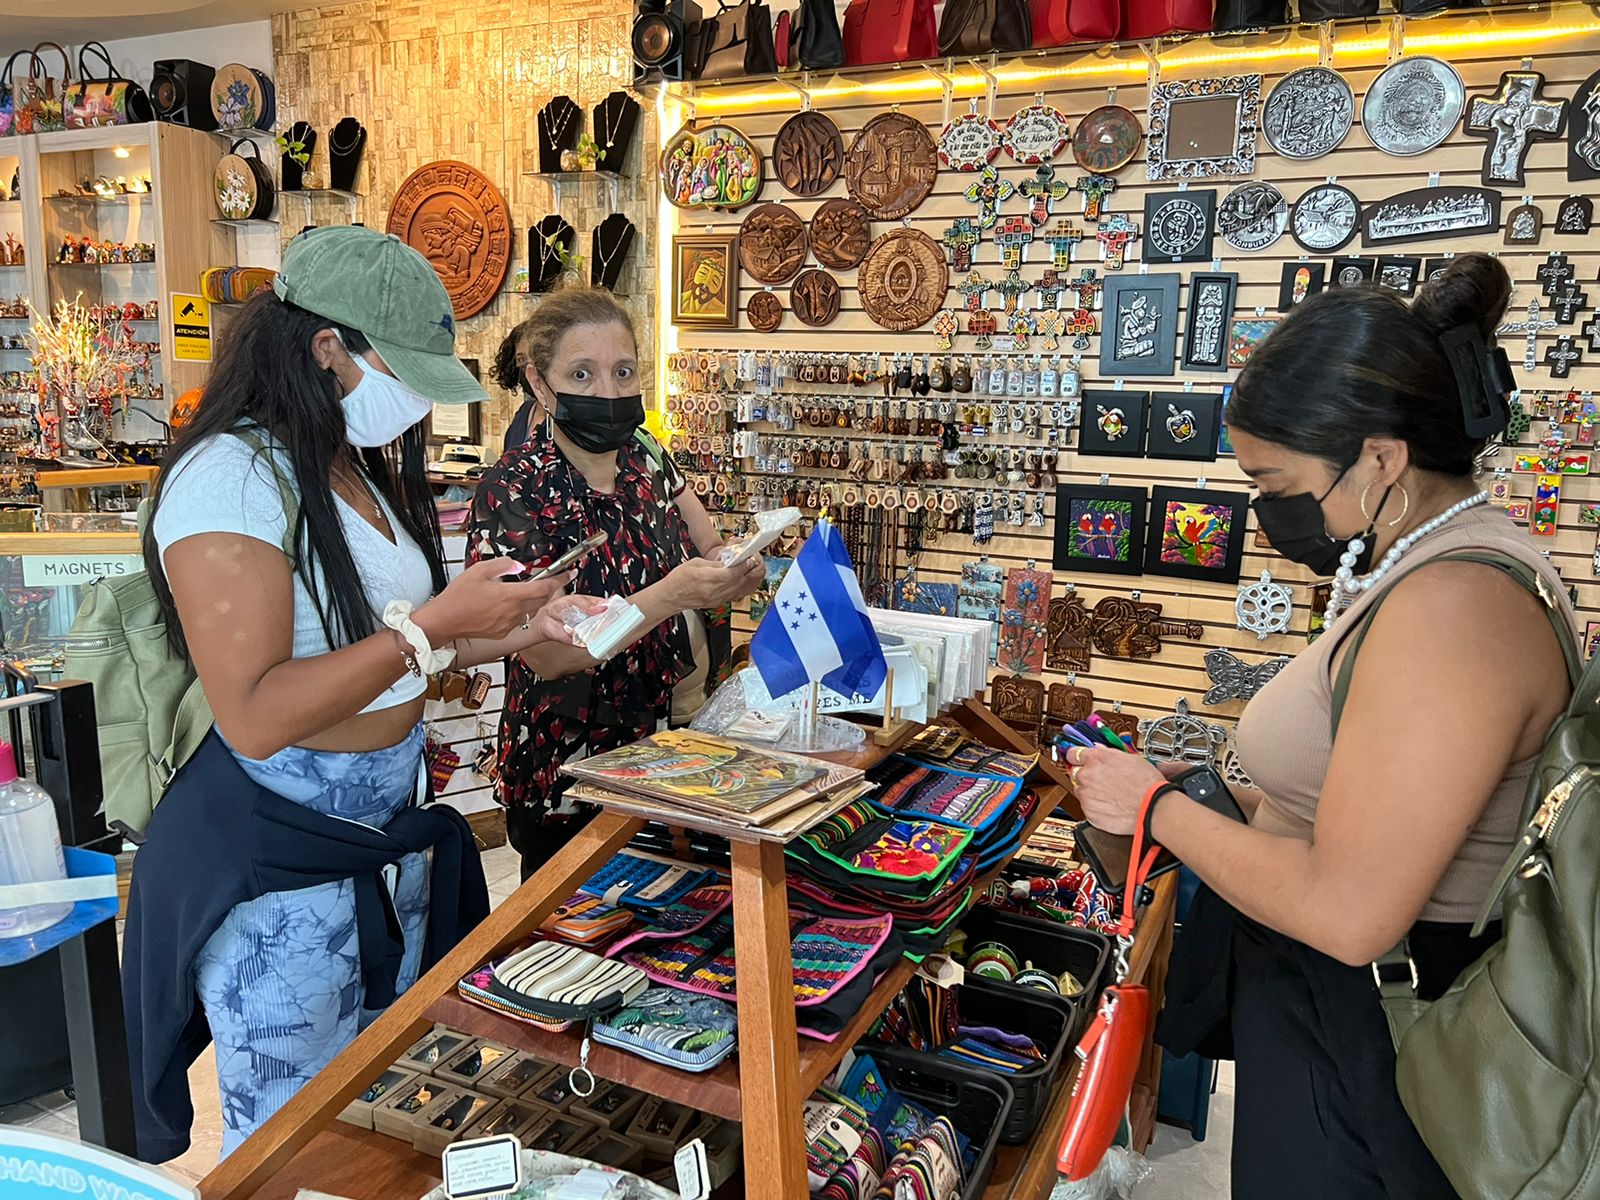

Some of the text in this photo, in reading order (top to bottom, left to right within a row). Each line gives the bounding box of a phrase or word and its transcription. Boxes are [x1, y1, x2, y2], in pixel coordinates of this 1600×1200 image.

[176, 327, 209, 336] ATENCIÓN
[44, 562, 125, 576] MAGNETS
[0, 1156, 87, 1194] HAND
